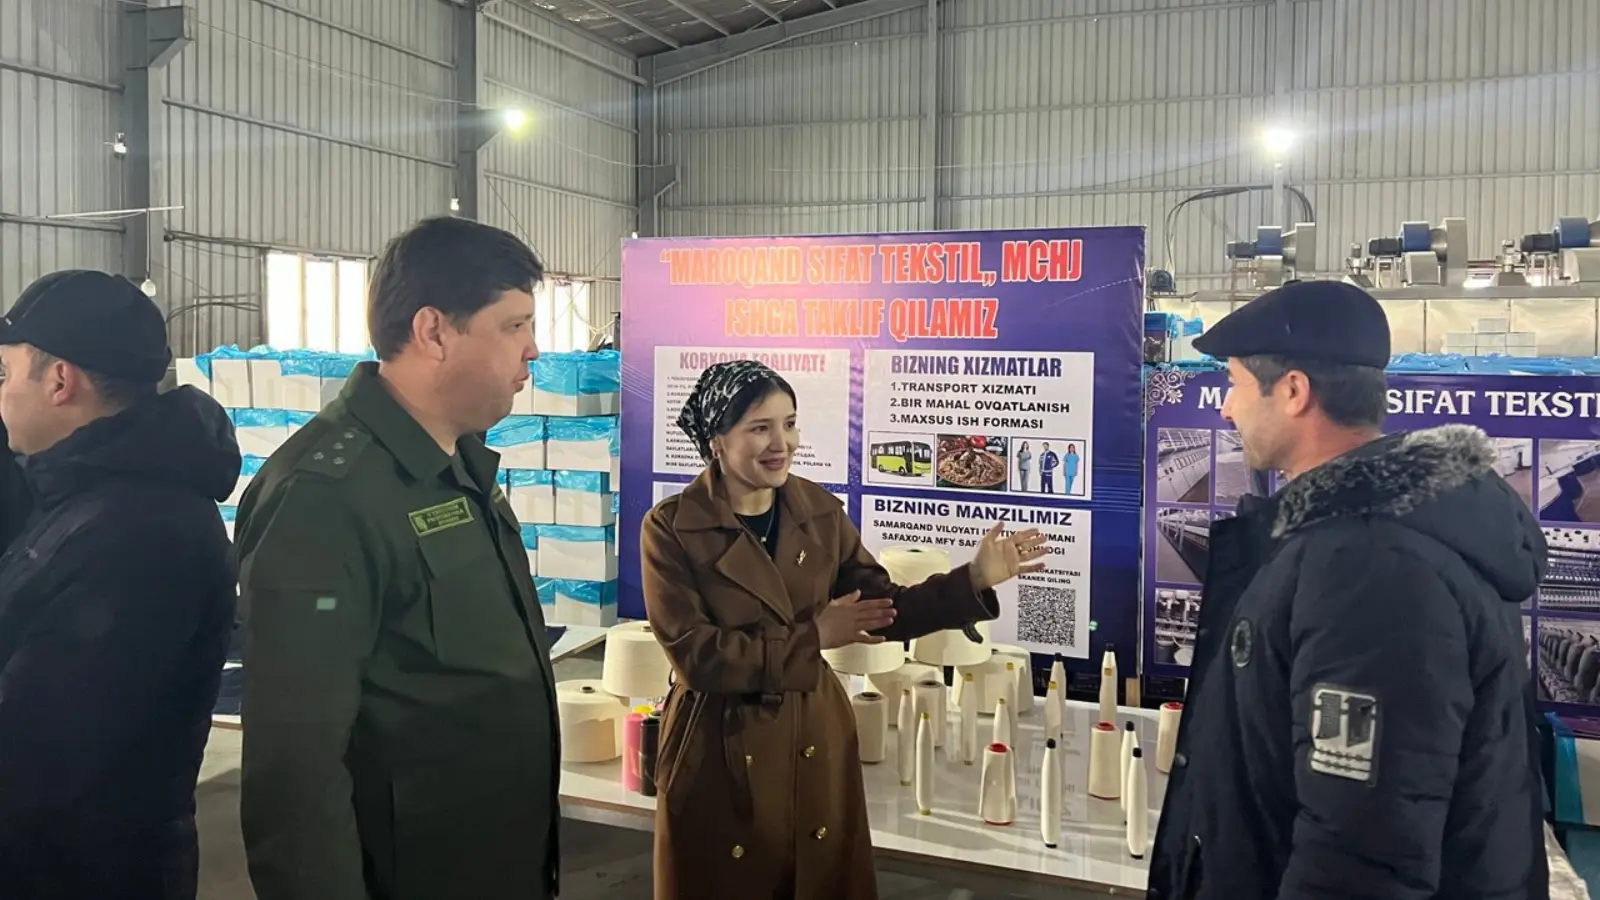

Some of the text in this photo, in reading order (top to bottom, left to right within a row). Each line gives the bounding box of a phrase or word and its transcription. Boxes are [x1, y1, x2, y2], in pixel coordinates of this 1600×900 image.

[807, 243, 874, 285] SIFAT
[1002, 239, 1082, 282] MCHJ
[725, 298, 998, 342] ISHGA TAKLIF QILAMIZ
[891, 355, 1062, 377] BIZNING XIZMATLAR
[891, 382, 1036, 395] 1.TRANSPORT XIZMATI
[890, 398, 1070, 413] 2.BIR MAHAL OVQATLANISH
[1386, 389, 1475, 416] SIFAT
[890, 413, 1043, 429] 3.MAXSUS ISH FORMASI
[874, 499, 1072, 526] BIZNING MANZILIMIZ
[873, 519, 932, 533] SAMARQAND
[936, 523, 979, 536] VILOYATI
[935, 535, 955, 546] MFY
